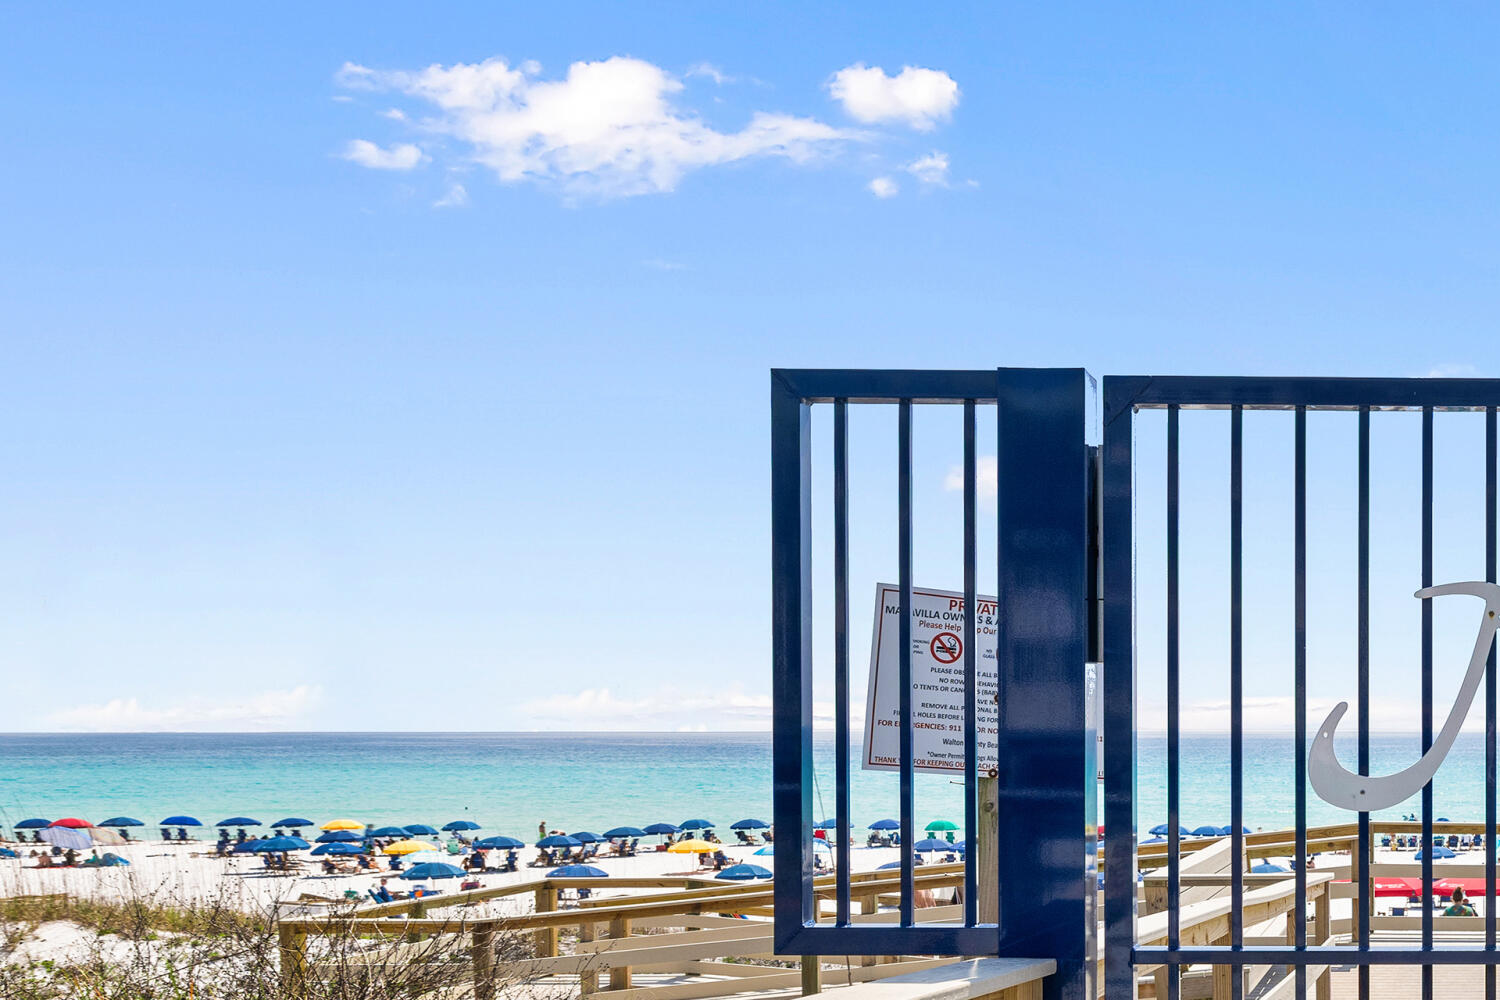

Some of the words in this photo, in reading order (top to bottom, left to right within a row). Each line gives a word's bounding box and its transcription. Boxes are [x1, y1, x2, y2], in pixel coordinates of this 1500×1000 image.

[885, 605, 940, 620] MAVILLA
[942, 611, 983, 625] OWNS
[918, 620, 942, 630] Please
[944, 622, 962, 633] Help
[983, 626, 997, 635] Our
[930, 666, 952, 675] PLEASE
[920, 684, 939, 692] TENTS
[921, 702, 948, 710] REMOVE
[917, 711, 936, 719] HOLES
[878, 719, 893, 727] FOR
[948, 723, 962, 732] 911
[942, 738, 964, 746] Walton
[927, 759, 953, 767] KEEPING
